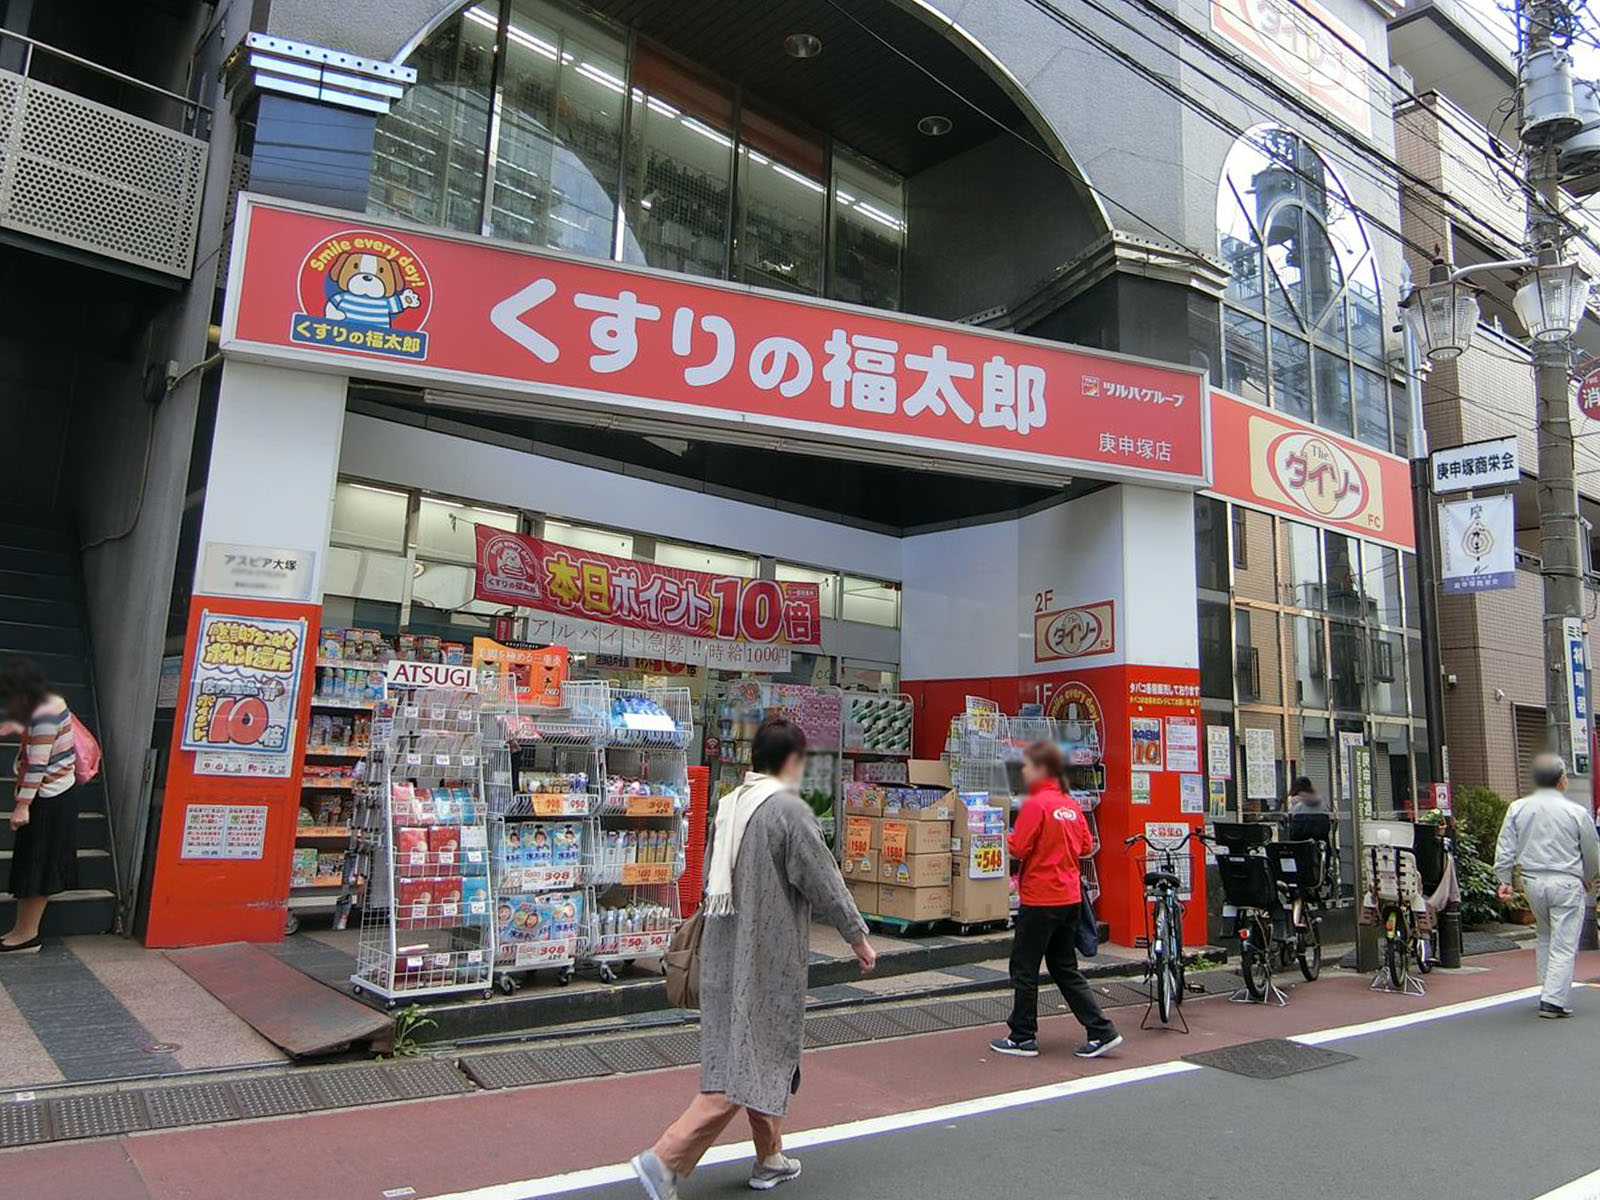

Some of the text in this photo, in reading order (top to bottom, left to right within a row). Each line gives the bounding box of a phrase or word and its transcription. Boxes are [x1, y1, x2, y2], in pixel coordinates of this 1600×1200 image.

[310, 238, 425, 287] Smile every day!
[296, 321, 420, 352] くすりの福太郎
[488, 278, 1047, 436] くすりの福太郎
[1103, 381, 1185, 407] ツルハグループ
[1099, 432, 1172, 462] 庚申塚店
[1285, 451, 1361, 500] ダイソー
[1437, 452, 1514, 480] 庚申塚商栄会
[1367, 513, 1381, 529] FC
[225, 554, 298, 570] アスピア大塚
[1035, 589, 1054, 613] 2F
[393, 664, 471, 687] ATSUGI
[1034, 683, 1053, 705] 1F
